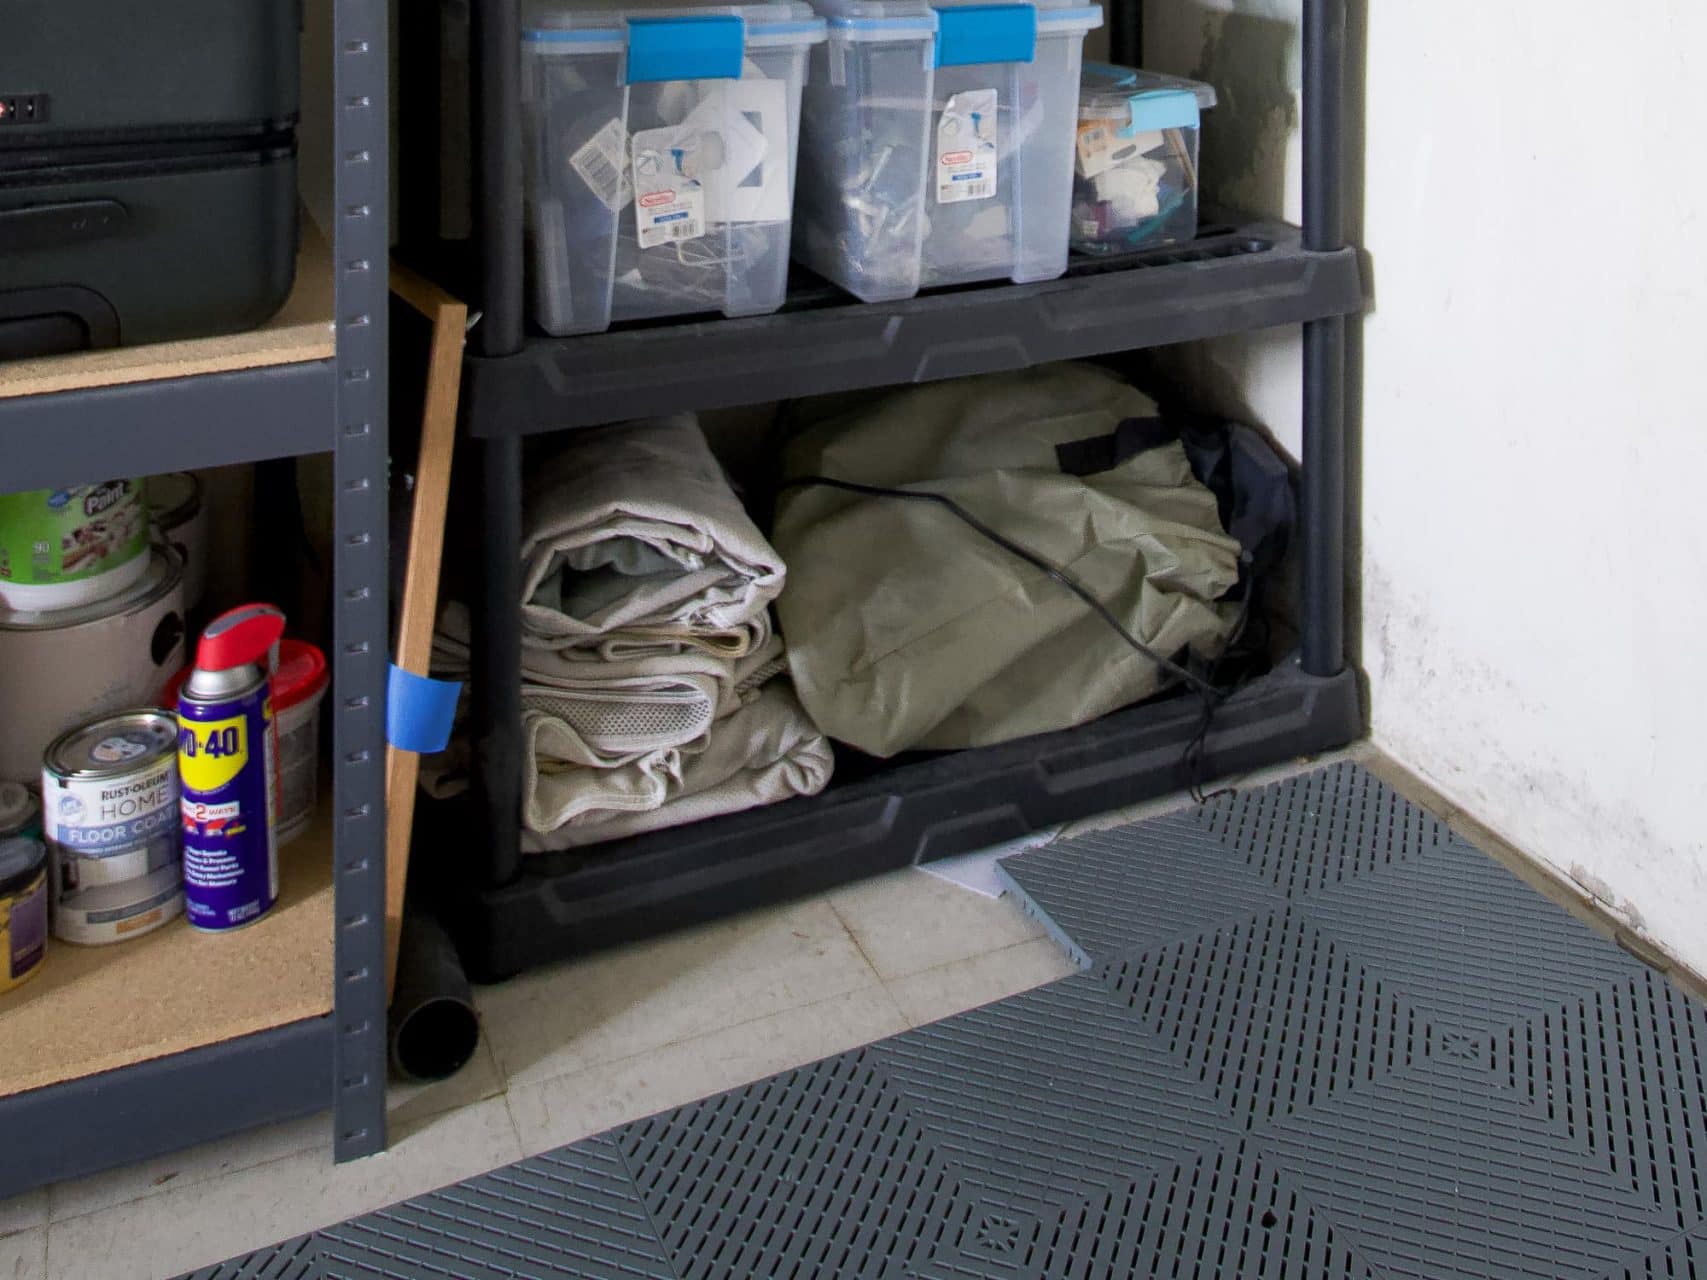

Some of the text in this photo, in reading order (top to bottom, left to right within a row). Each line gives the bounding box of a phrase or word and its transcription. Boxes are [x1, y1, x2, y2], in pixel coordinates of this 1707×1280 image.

[102, 784, 169, 820] HOME
[195, 804, 206, 820] 2
[71, 825, 127, 842] FLOOR
